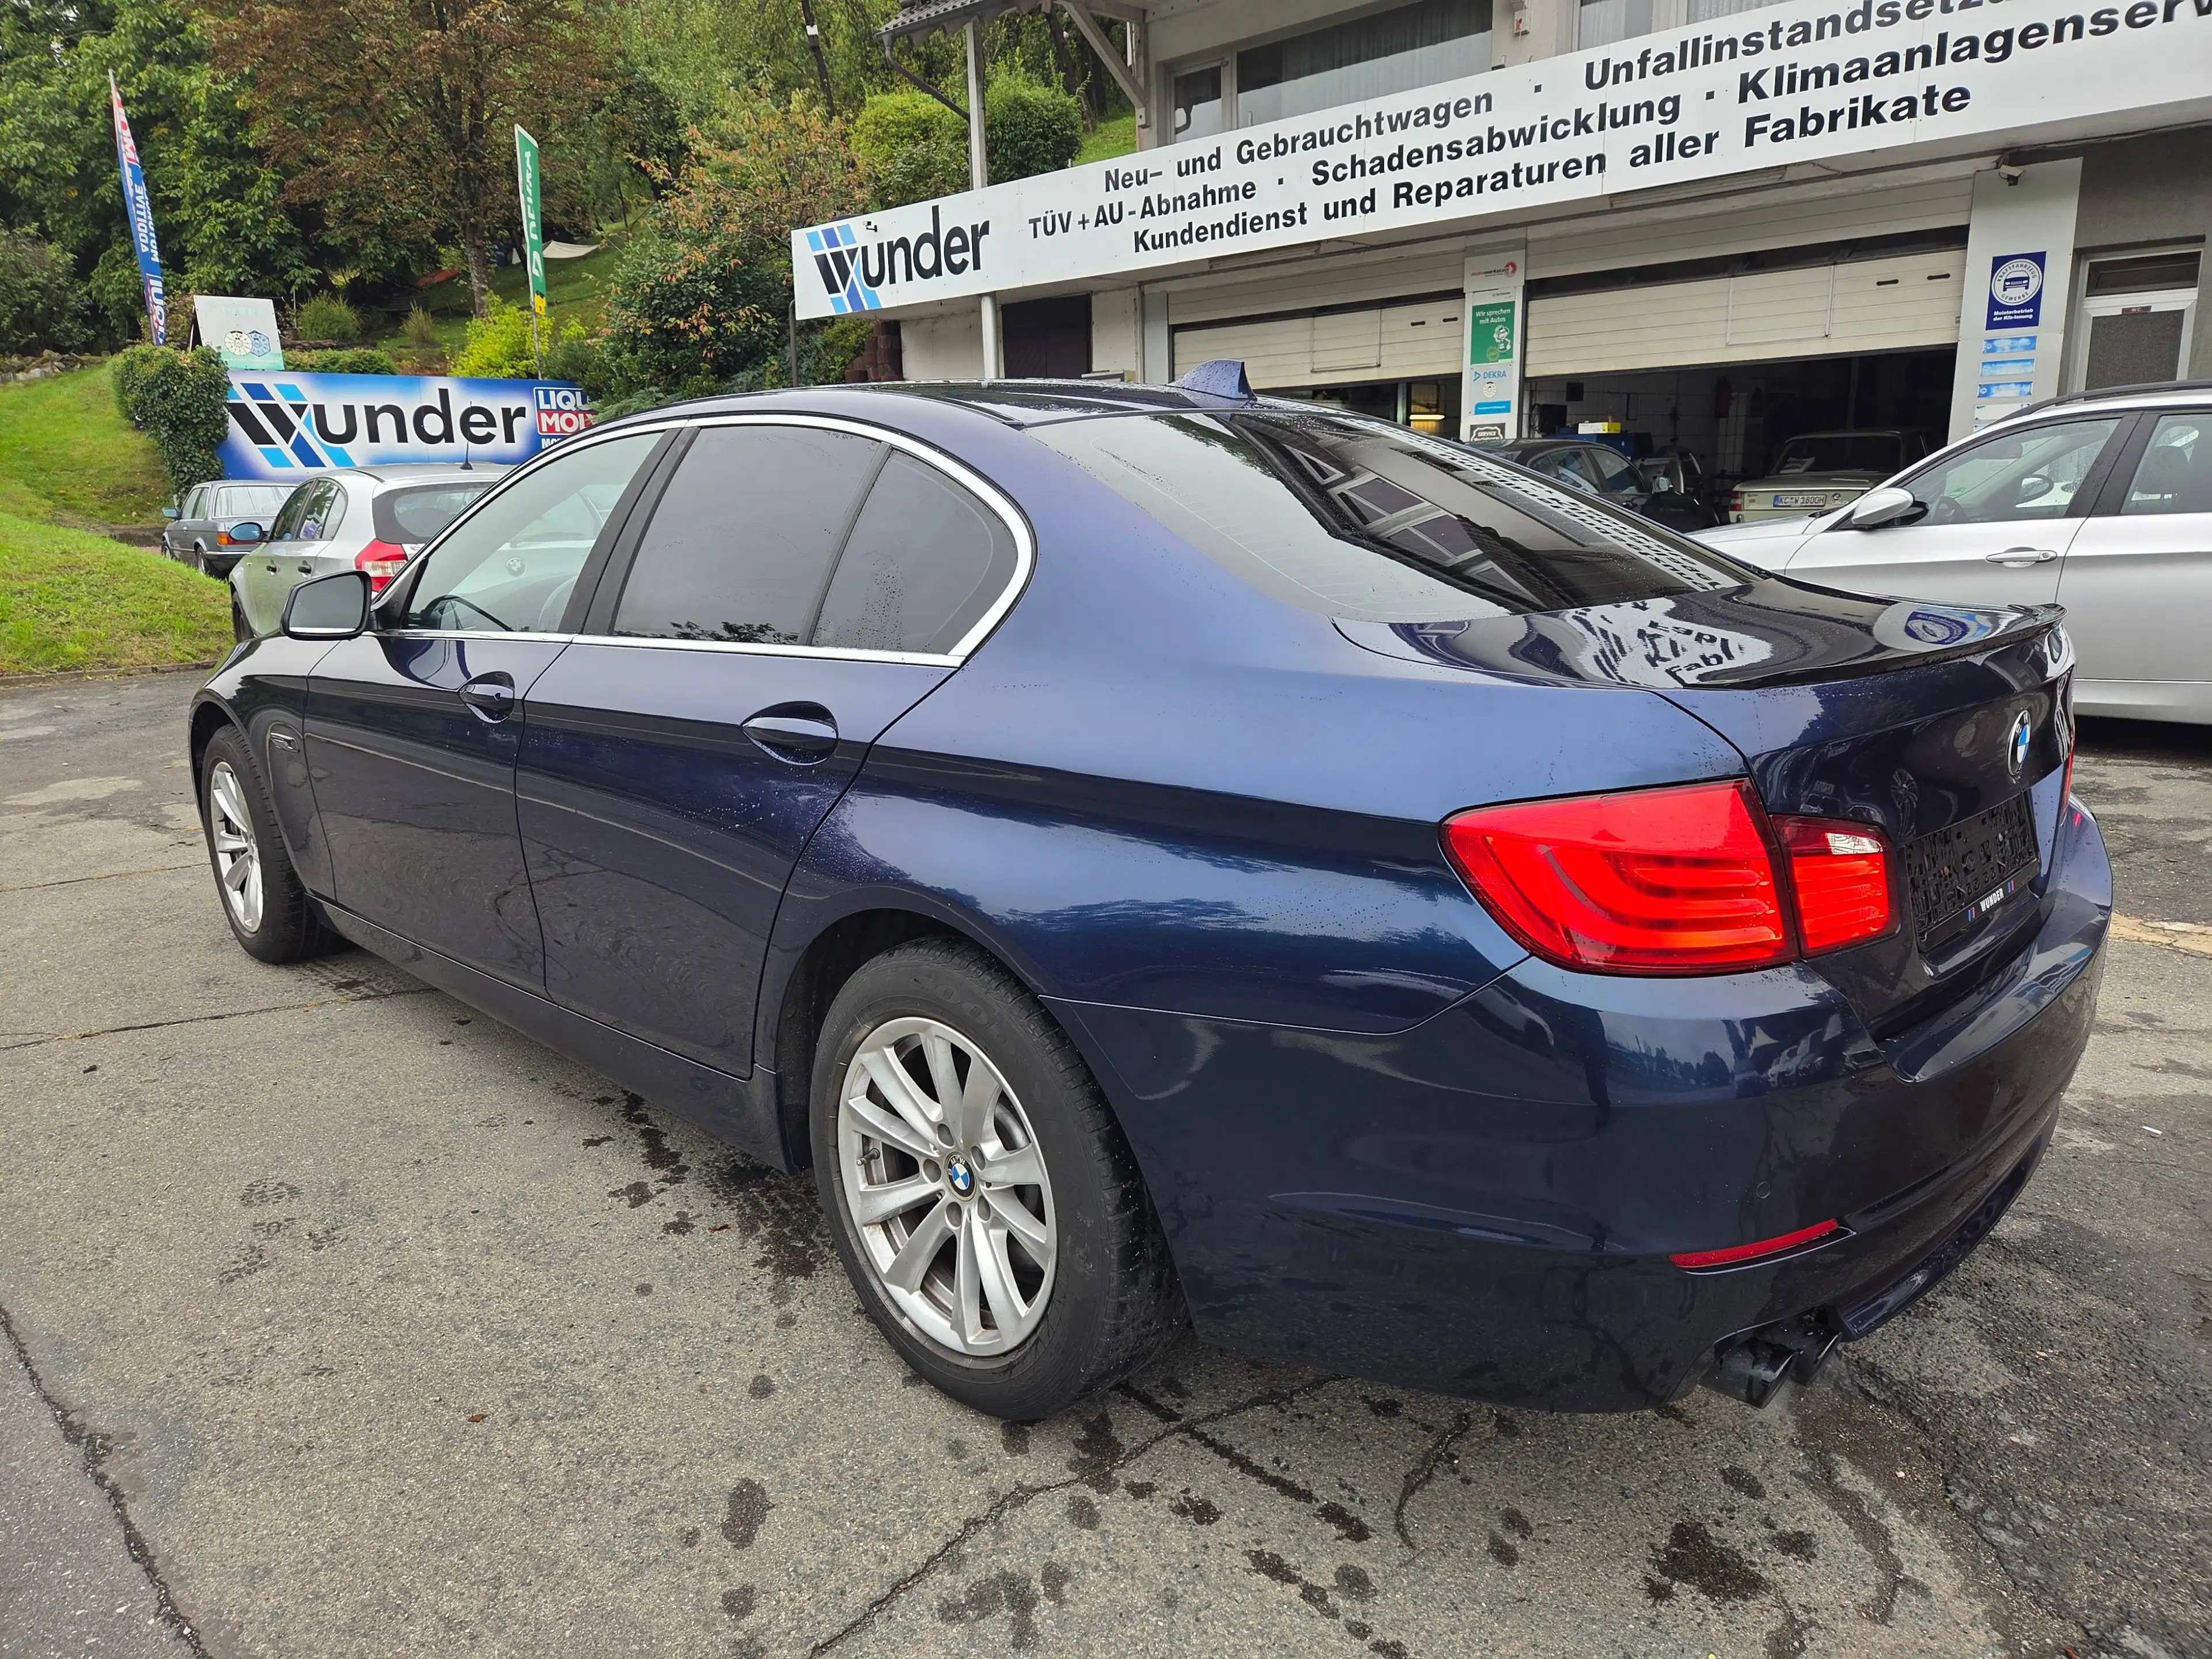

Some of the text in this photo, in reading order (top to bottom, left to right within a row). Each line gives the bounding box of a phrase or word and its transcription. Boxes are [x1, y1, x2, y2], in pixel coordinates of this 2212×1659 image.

[1177, 146, 1221, 177] und
[1237, 93, 1492, 165] Gebrauchtwagen
[1586, 0, 2014, 89] Unfallinstandse
[1029, 209, 1072, 238] TÜV
[1312, 94, 1680, 186] Schadensabwicklung
[1134, 84, 1971, 253] Kundendienst und Reparaturen aller Fabrikate
[809, 204, 990, 302] Wunder
[1486, 308, 1510, 317] sprechen
[537, 390, 592, 411] LIQU
[1483, 370, 1507, 380] DEKRA
[228, 385, 526, 458] Wunder
[1980, 888, 2004, 912] WUNDER
